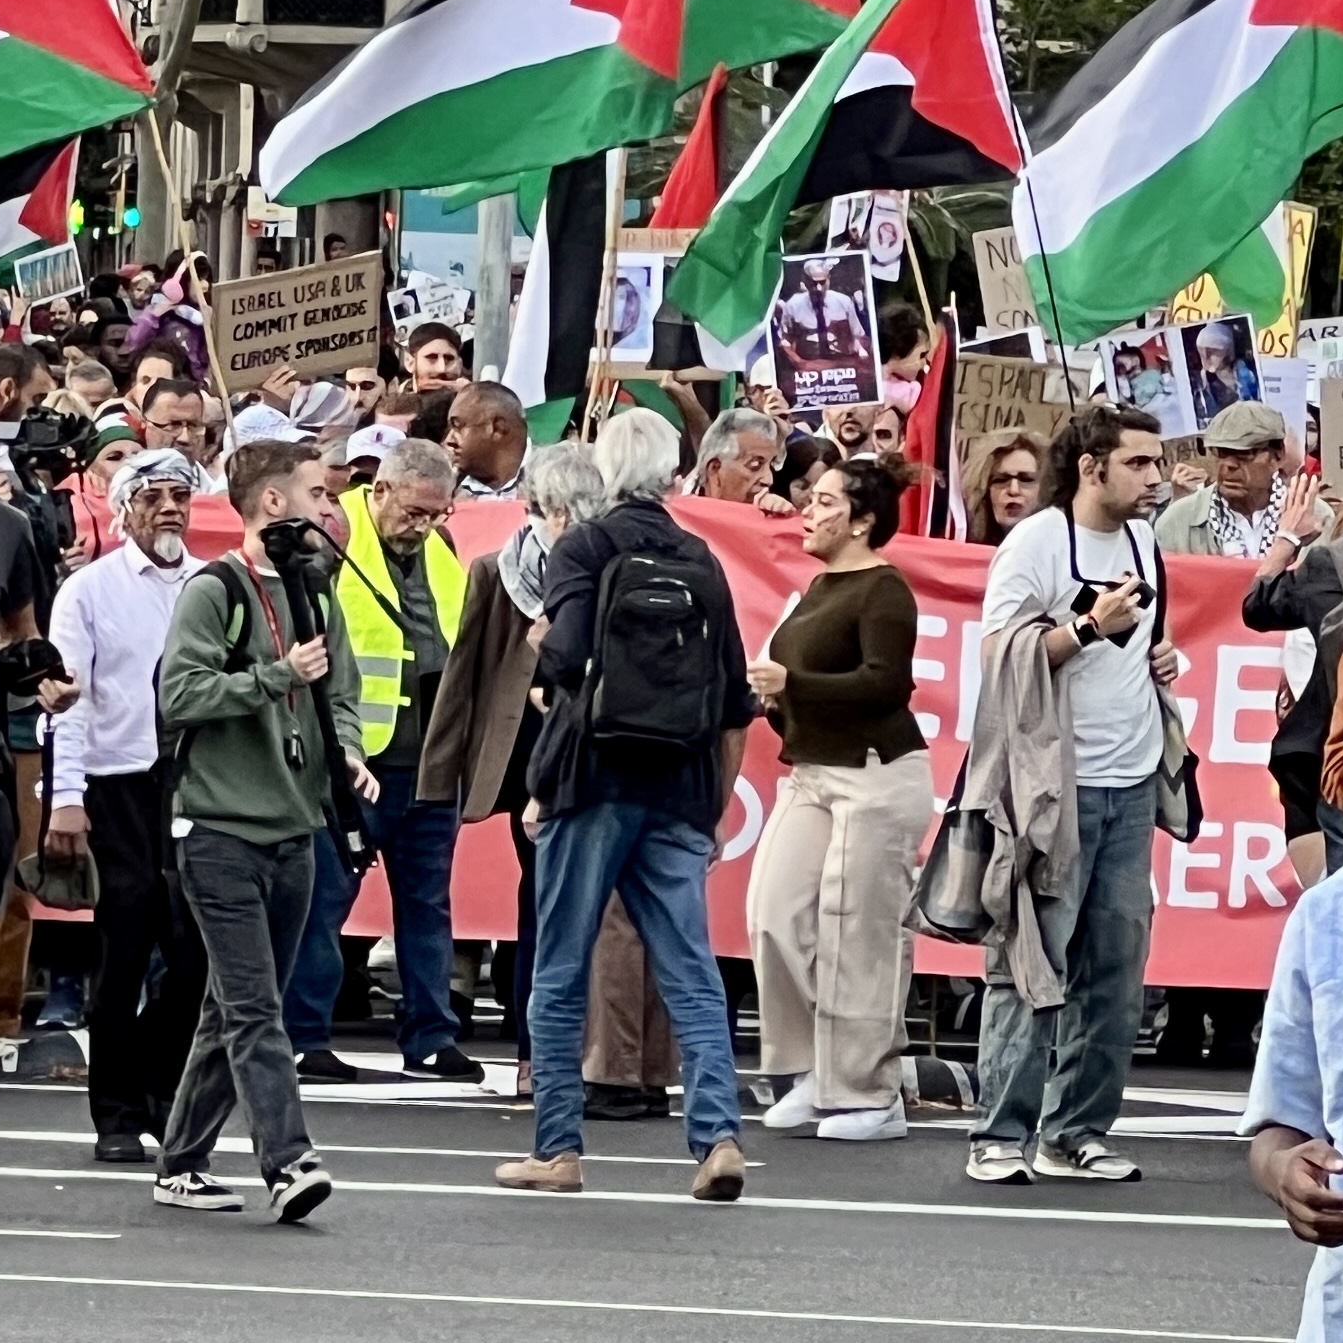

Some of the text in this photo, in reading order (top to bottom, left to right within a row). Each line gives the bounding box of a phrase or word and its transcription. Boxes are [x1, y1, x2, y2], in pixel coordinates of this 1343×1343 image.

[294, 280, 326, 304] USA
[331, 275, 341, 298] &
[346, 272, 366, 293] UK
[233, 300, 368, 341] COMMIT GENOCIDE
[230, 343, 291, 371] EUROPE
[295, 329, 364, 360] SPONSORS
